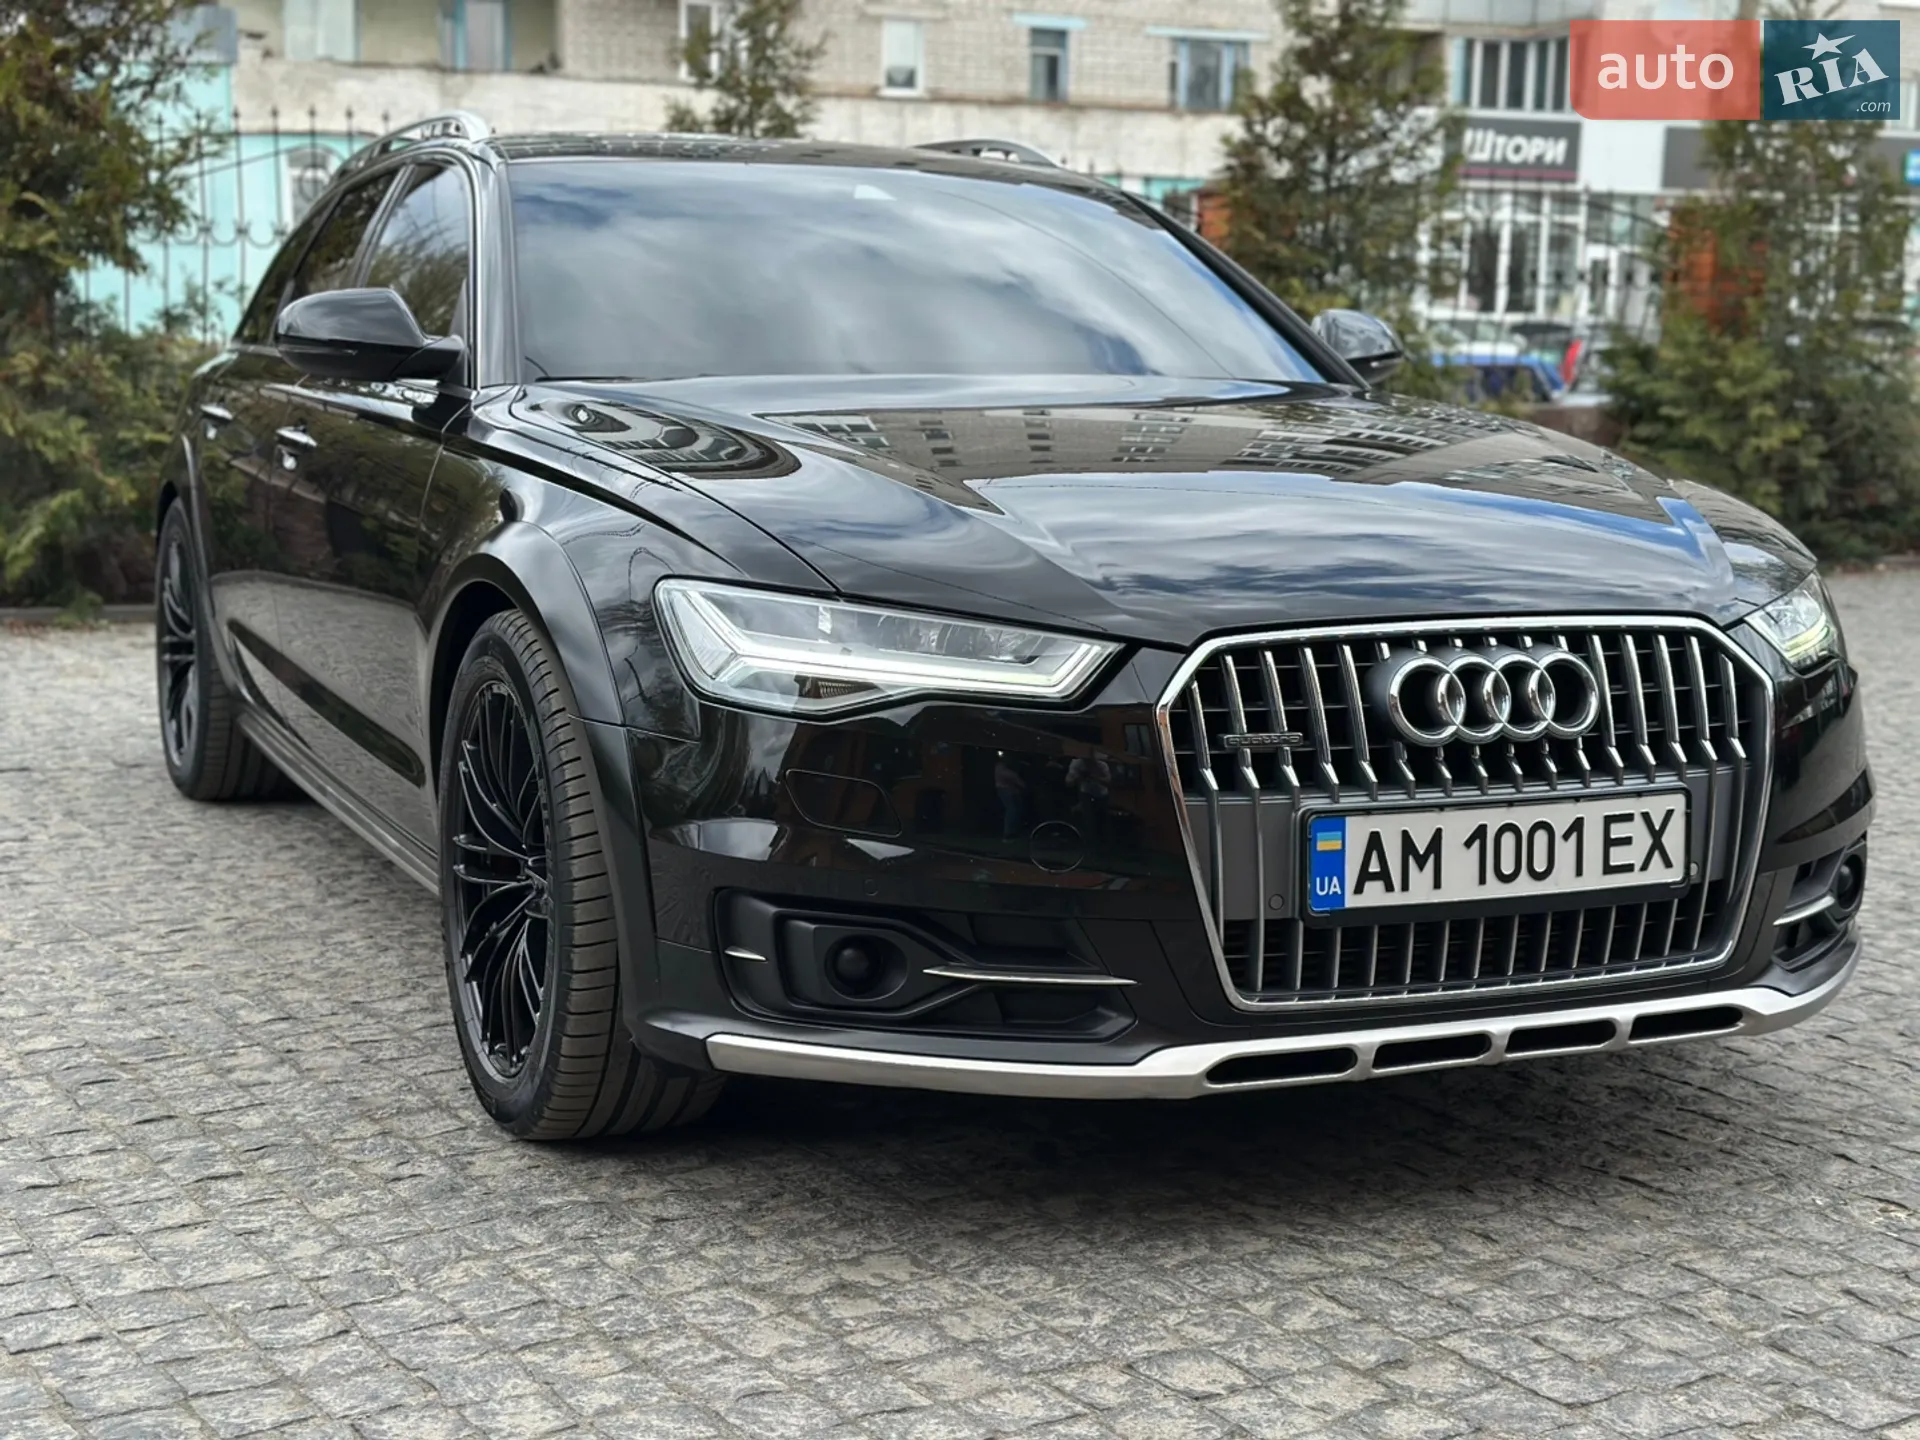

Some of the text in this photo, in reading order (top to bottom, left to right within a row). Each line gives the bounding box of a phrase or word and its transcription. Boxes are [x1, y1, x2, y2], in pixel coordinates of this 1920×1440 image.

[1462, 128, 1568, 165] ШТОРИ
[1353, 808, 1676, 895] AM 1001 EX
[1316, 876, 1342, 897] UA
